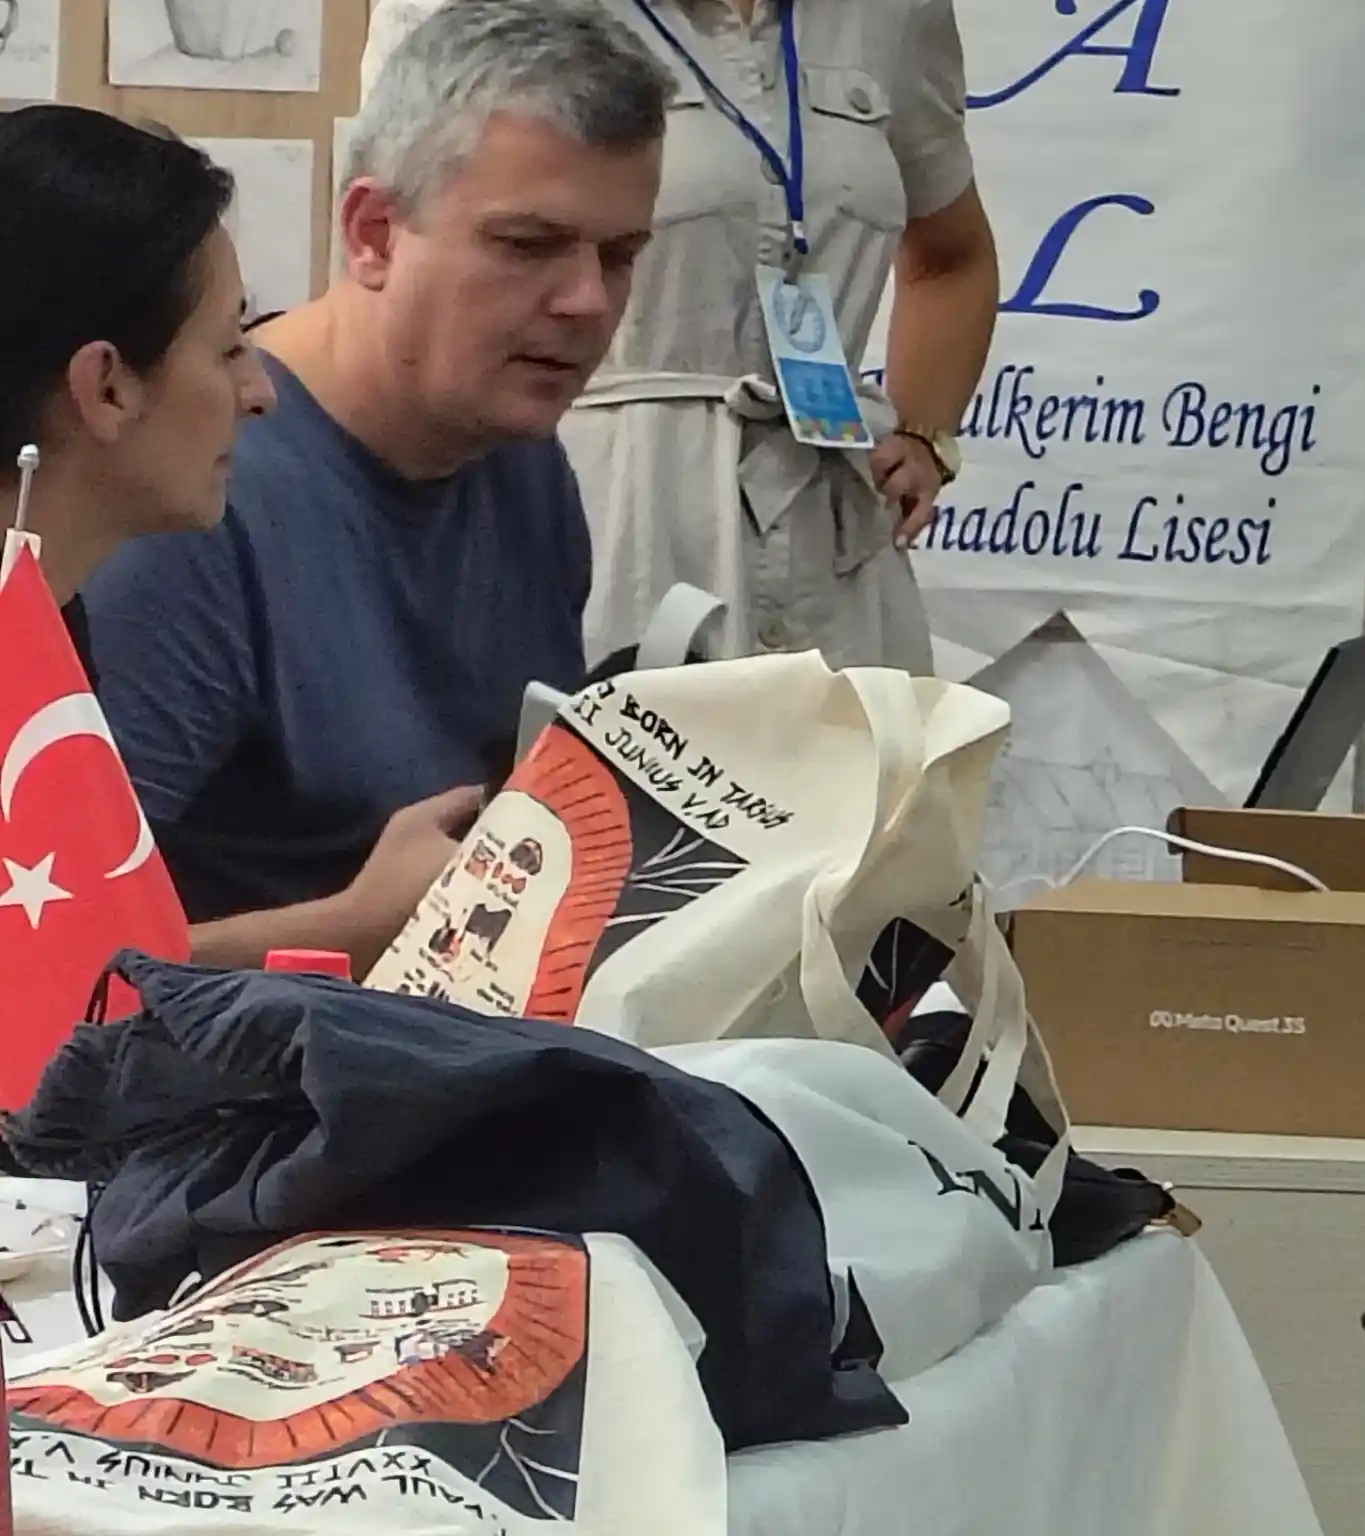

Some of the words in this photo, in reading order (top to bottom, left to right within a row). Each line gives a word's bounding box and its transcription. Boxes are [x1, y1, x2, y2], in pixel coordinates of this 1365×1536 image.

[955, 363, 1146, 460] ulkerim
[1162, 381, 1321, 476] Bengi
[908, 480, 1103, 559] nadolu
[1117, 495, 1277, 566] Lisesi
[606, 727, 685, 793] JUNIUS
[620, 693, 689, 760] BORN
[687, 755, 725, 788] IN
[94, 1450, 252, 1490] JUNIUS
[138, 1486, 255, 1513] BORN
